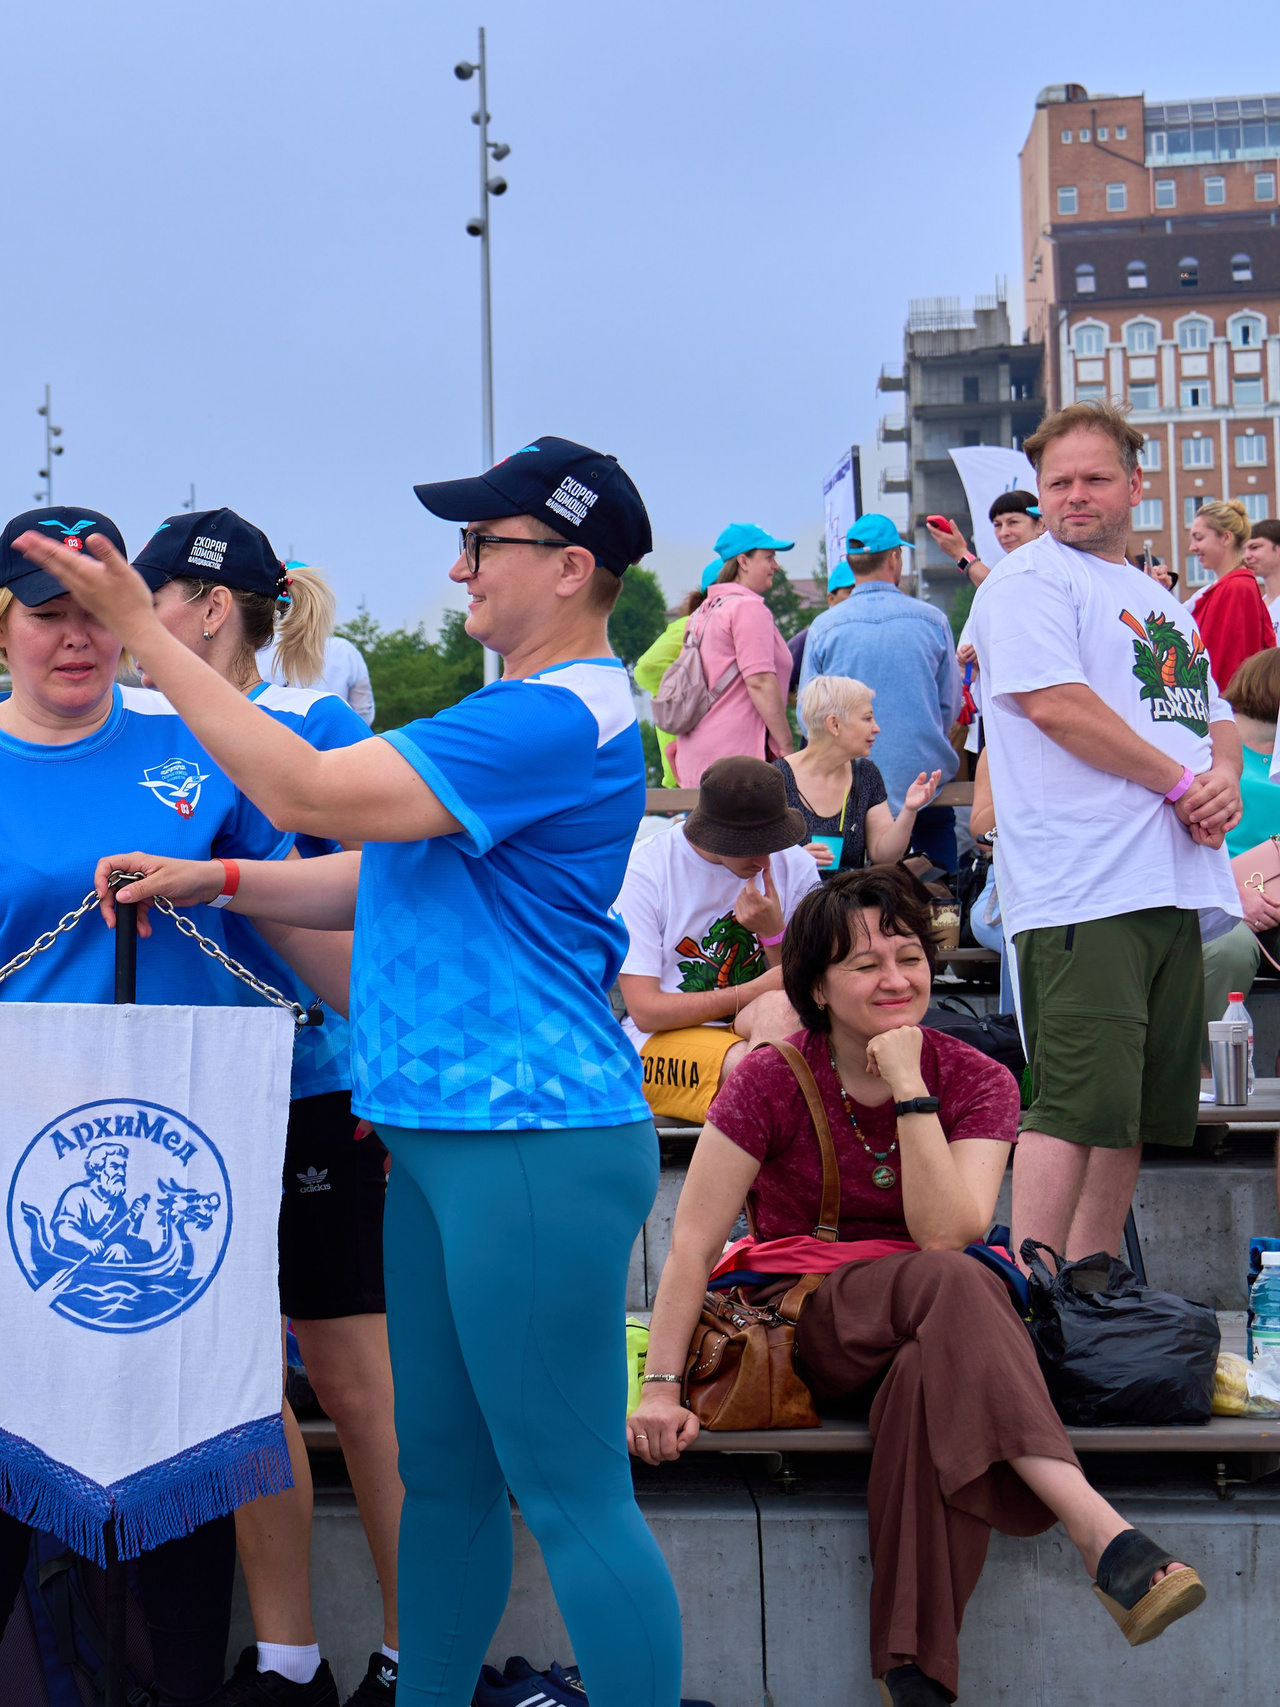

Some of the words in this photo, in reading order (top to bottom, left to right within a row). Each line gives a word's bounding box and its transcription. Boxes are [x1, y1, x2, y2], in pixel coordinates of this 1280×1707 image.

[551, 487, 588, 518] ПОМОЩЬ
[560, 476, 599, 508] СКОРАЯ
[190, 546, 224, 563] ПОМОЩЬ
[194, 536, 228, 553] СКОРАЯ
[640, 1055, 700, 1090] ORNIA
[49, 1110, 198, 1167] АрхиМед
[300, 1183, 331, 1194] adidas
